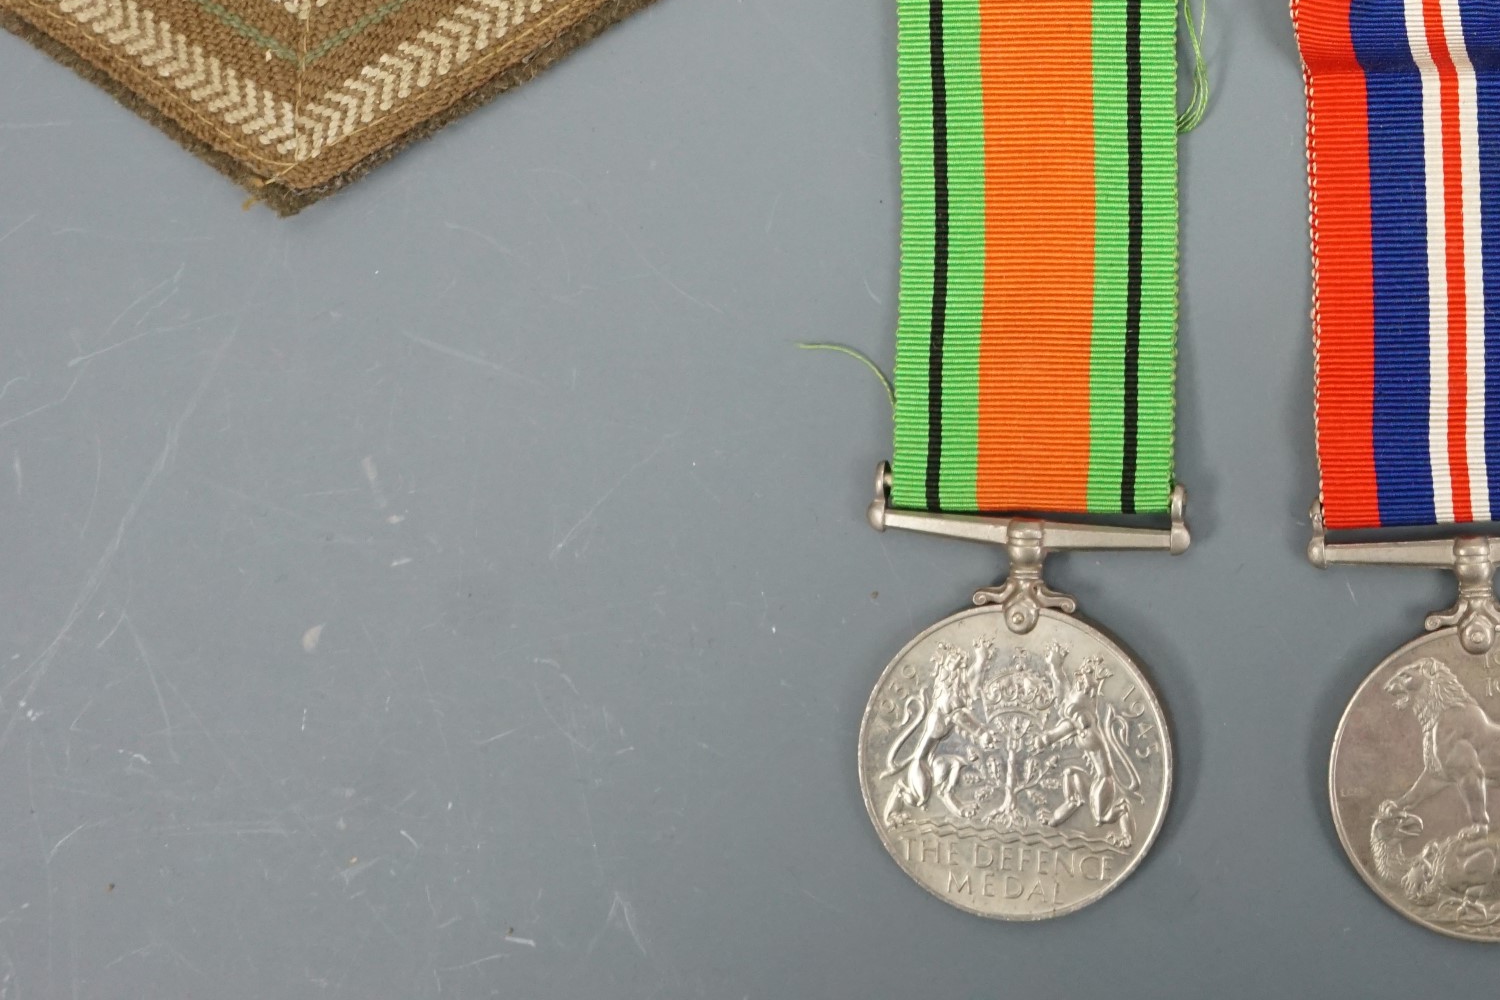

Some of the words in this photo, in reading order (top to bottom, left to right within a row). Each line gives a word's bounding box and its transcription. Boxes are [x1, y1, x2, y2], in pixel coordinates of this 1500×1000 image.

[1121, 684, 1160, 759] 1945
[904, 838, 960, 866] THE
[973, 842, 1114, 881] DEFENCE
[947, 871, 1065, 905] MEDAL
